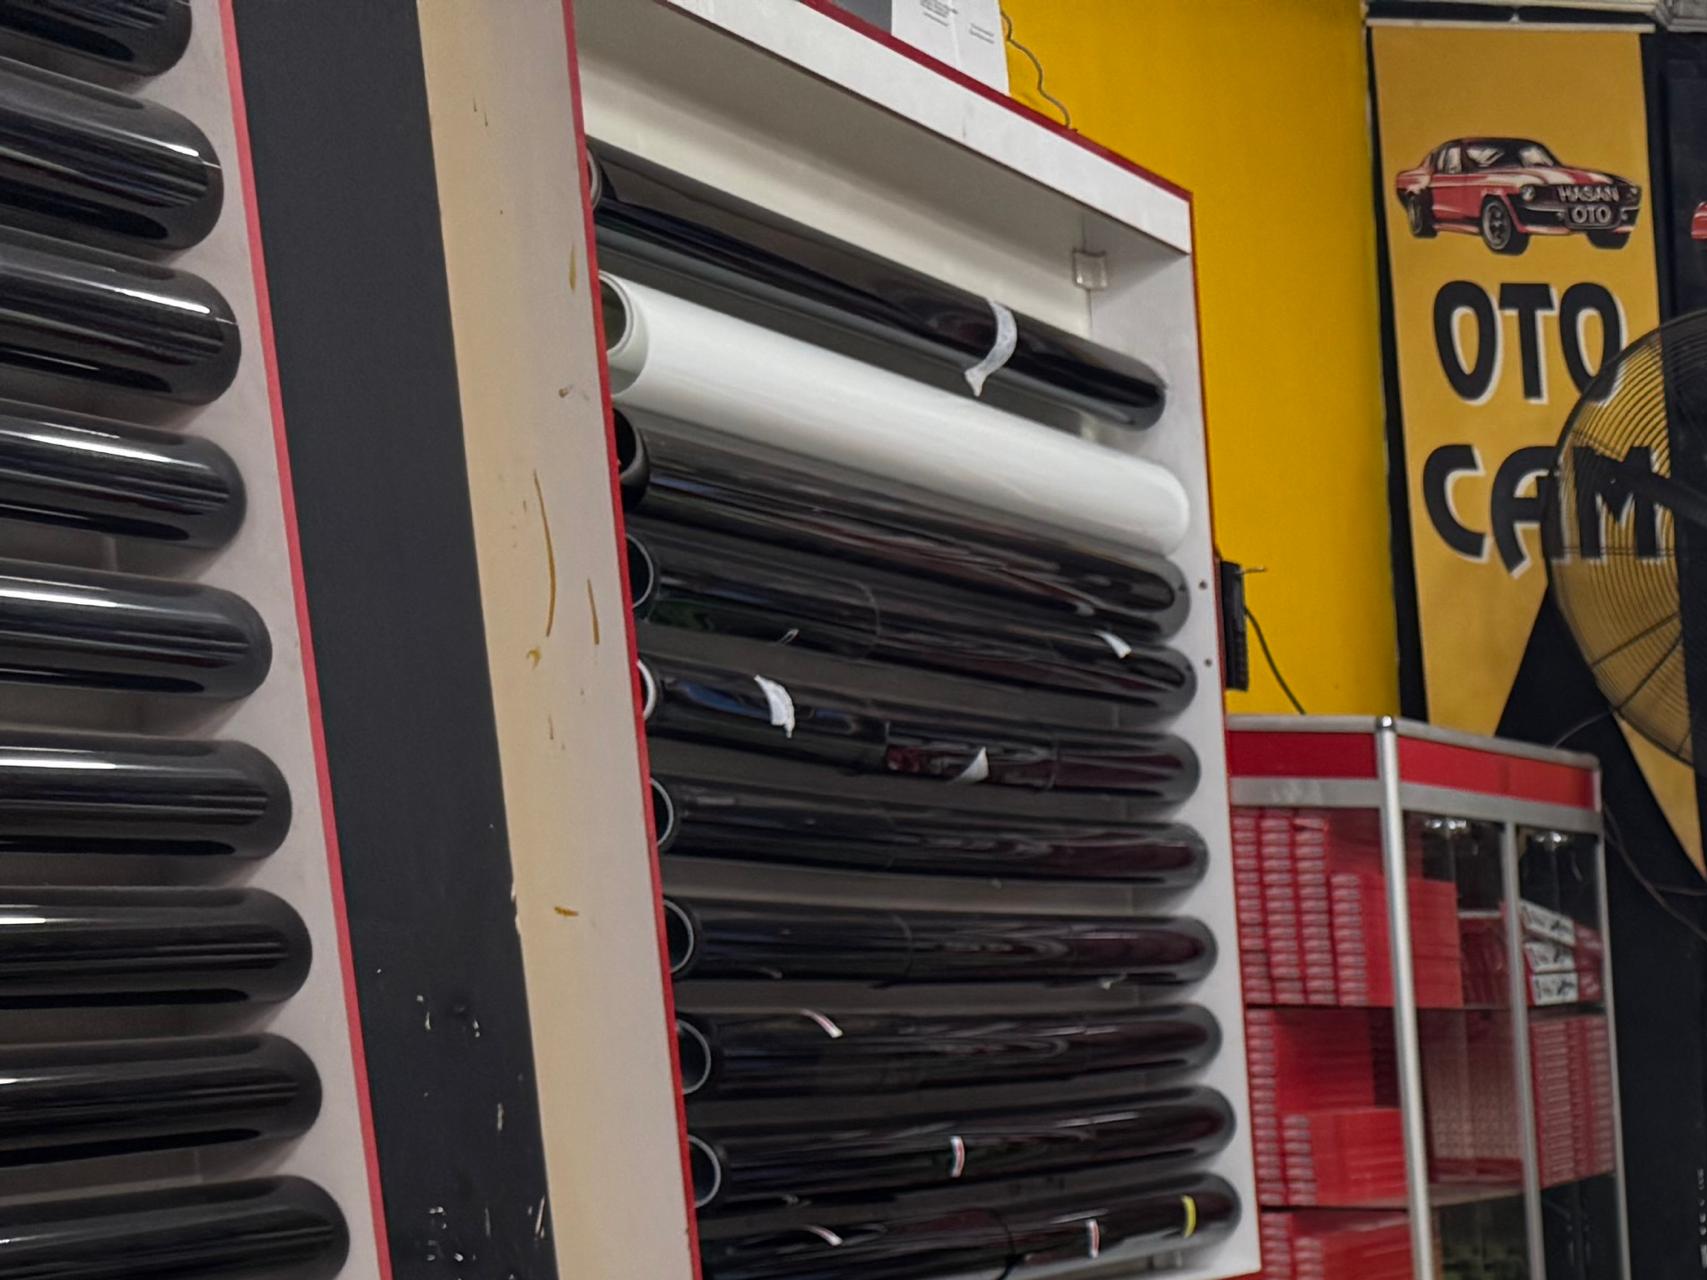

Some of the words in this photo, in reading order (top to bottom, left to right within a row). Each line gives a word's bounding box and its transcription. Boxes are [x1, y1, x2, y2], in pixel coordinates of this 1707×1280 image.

[1557, 186, 1619, 201] HASAN
[1572, 205, 1612, 223] OTO
[1433, 280, 1629, 405] OTO
[1422, 444, 1663, 580] CAM
